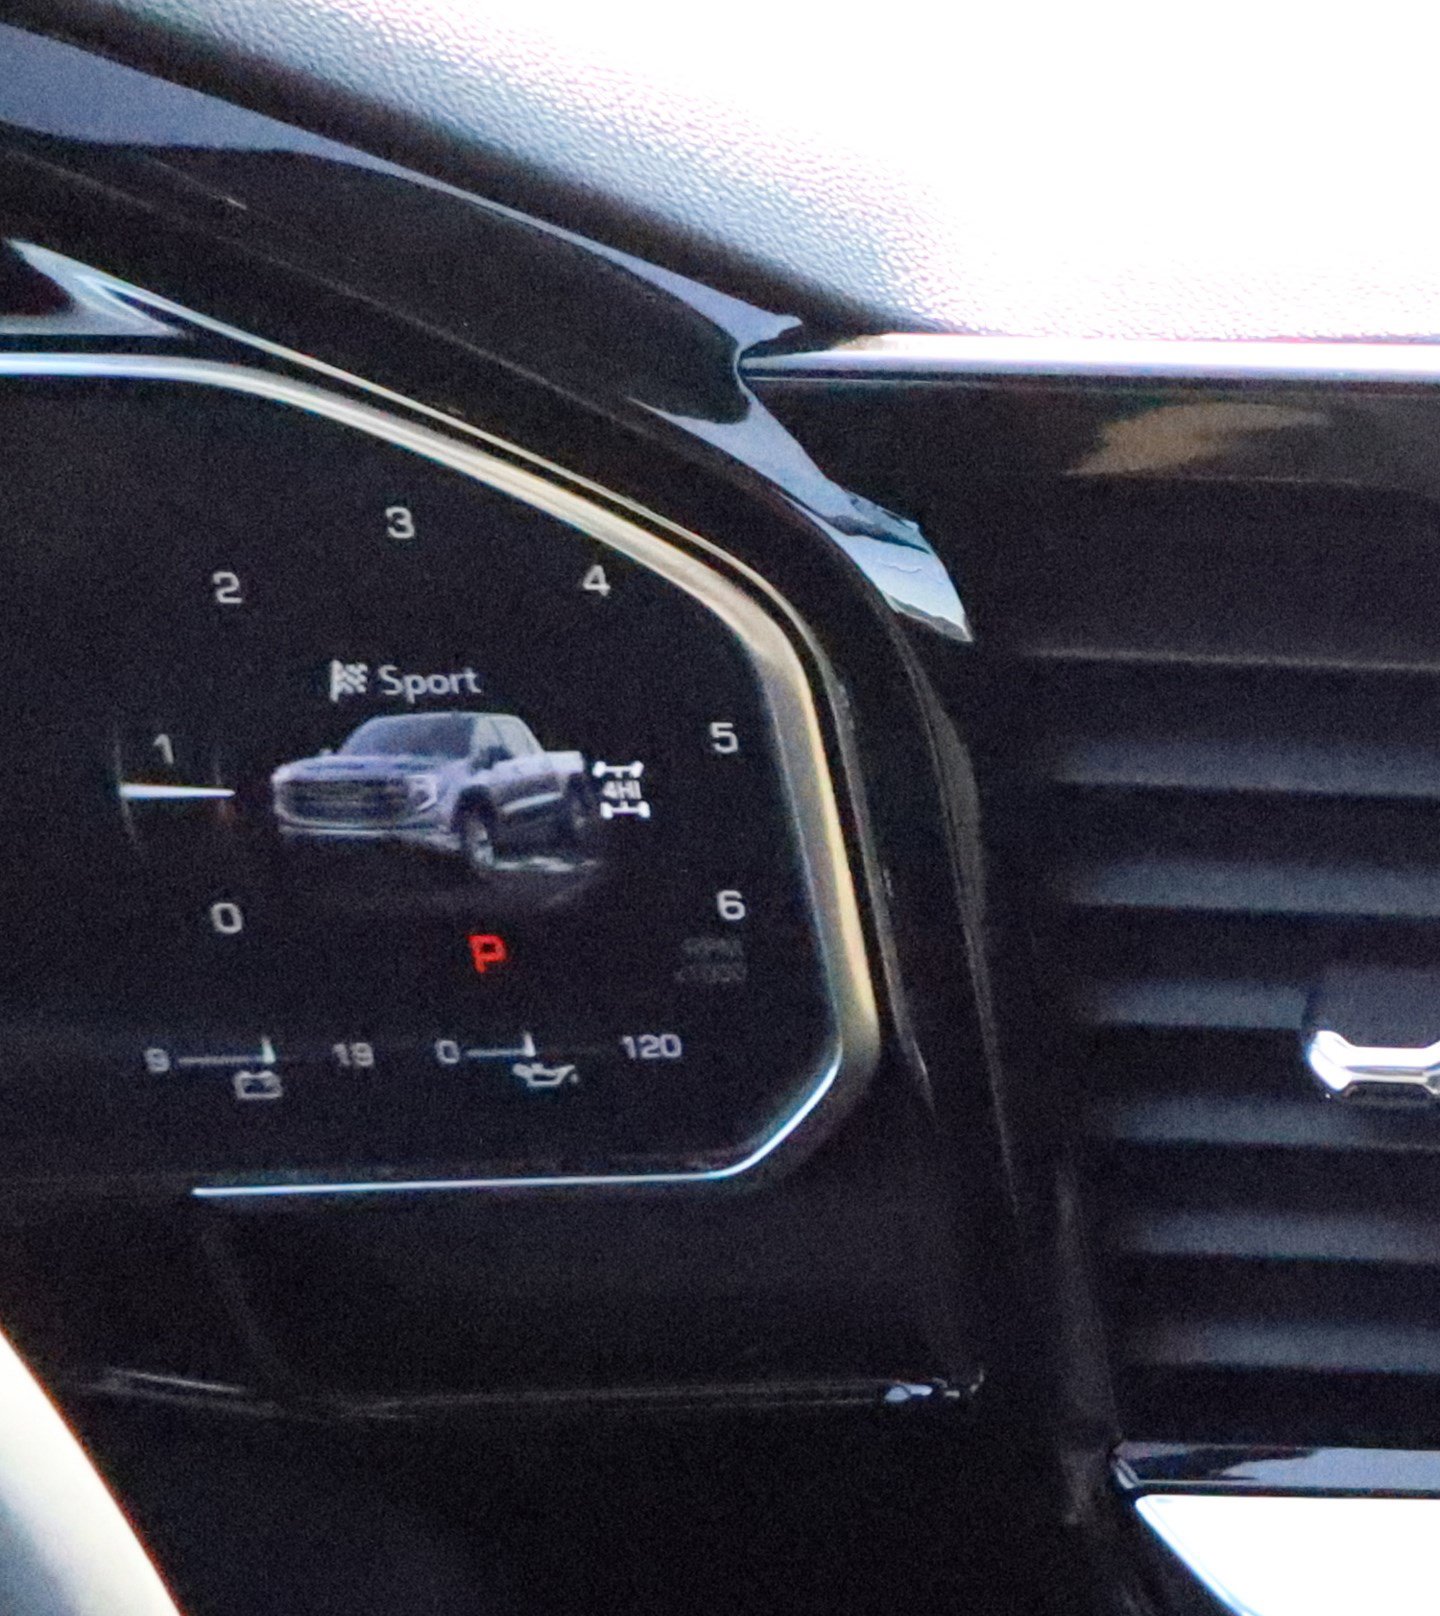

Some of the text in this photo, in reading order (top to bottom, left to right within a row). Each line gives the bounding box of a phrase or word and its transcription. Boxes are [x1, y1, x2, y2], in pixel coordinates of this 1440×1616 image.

[386, 506, 414, 539] 3
[213, 572, 242, 604] 2
[583, 565, 610, 595] 4
[378, 665, 481, 703] Sport
[154, 734, 173, 763] 1
[710, 722, 738, 753] 5
[211, 903, 242, 934] 0
[717, 890, 745, 920] 6
[469, 935, 505, 972] P
[145, 1048, 170, 1072] 9
[333, 1042, 374, 1066] 19
[435, 1040, 460, 1064] 0
[622, 1034, 682, 1059] 120
